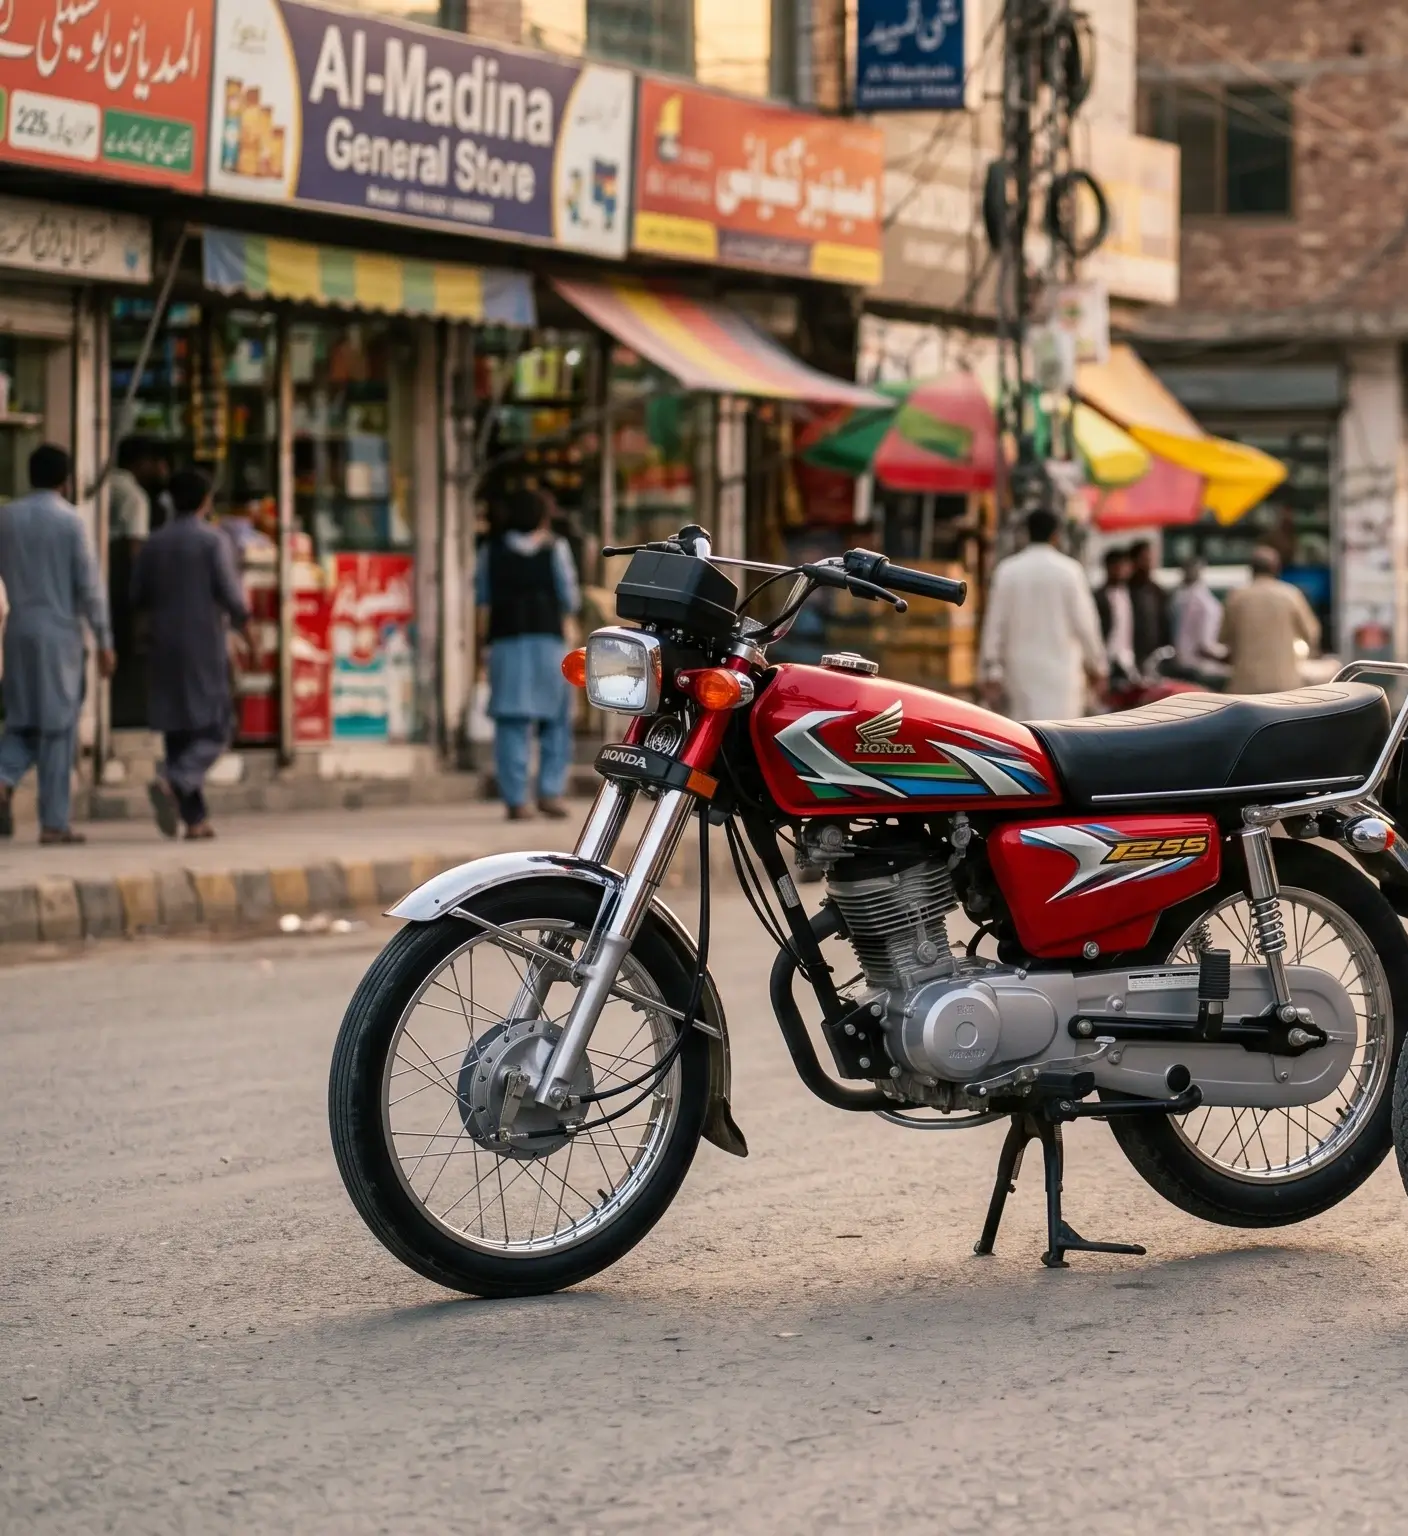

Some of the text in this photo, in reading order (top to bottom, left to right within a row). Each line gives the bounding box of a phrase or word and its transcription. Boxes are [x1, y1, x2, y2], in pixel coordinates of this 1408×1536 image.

[308, 24, 554, 148] Al-Madina
[325, 116, 536, 203] General Store
[855, 743, 917, 754] HONDA
